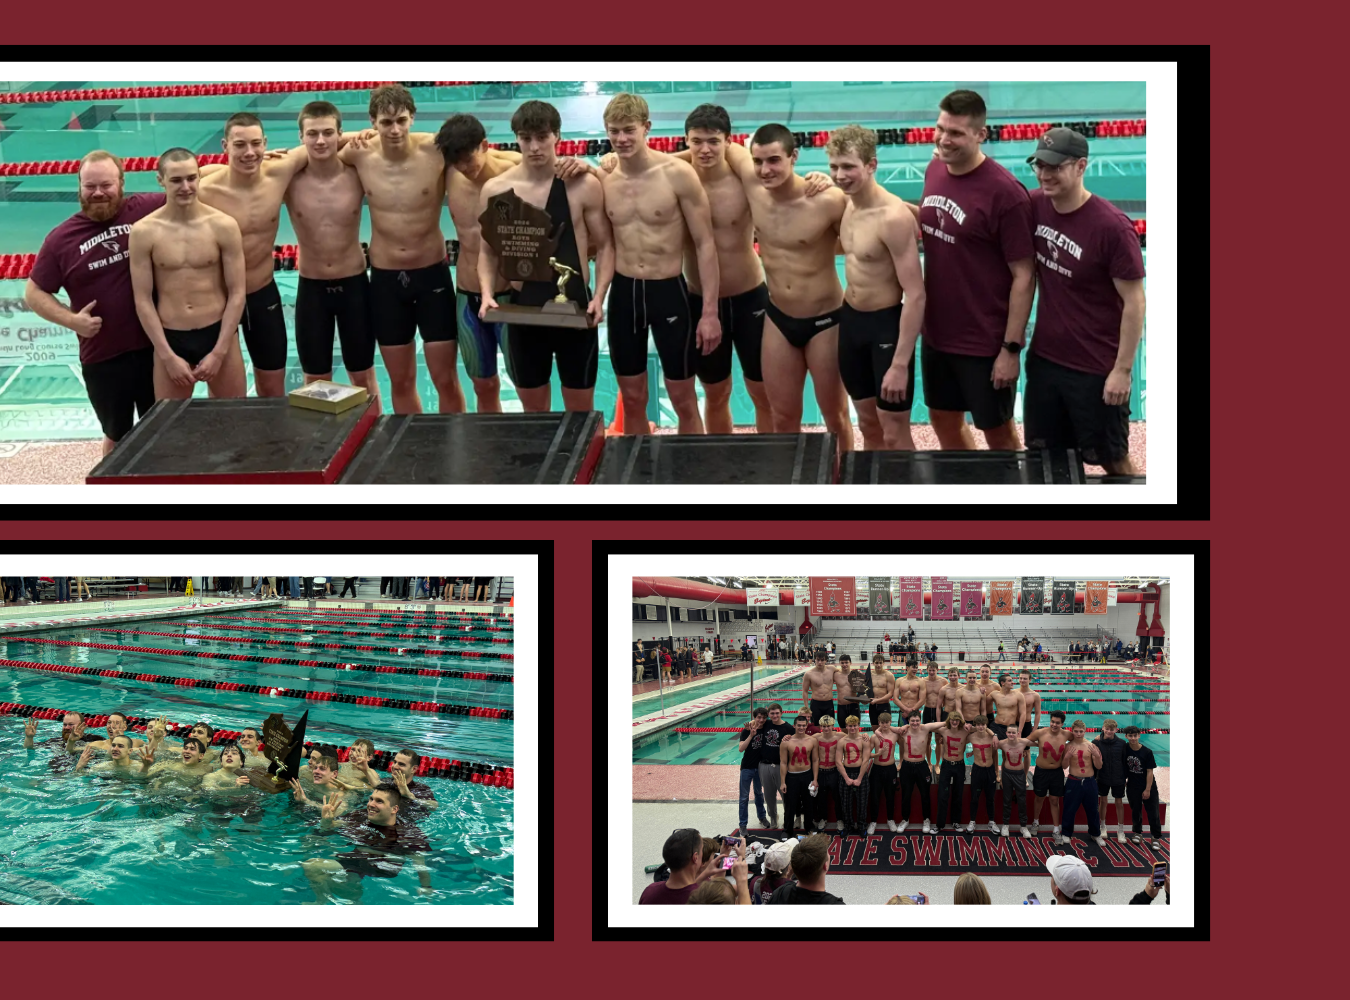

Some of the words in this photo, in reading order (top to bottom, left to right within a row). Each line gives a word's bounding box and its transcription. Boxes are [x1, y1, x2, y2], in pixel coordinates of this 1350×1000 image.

[921, 195, 967, 226] MIDDLETON
[497, 225, 515, 234] STATE
[88, 258, 108, 271] SWIM
[326, 285, 344, 294] TYR
